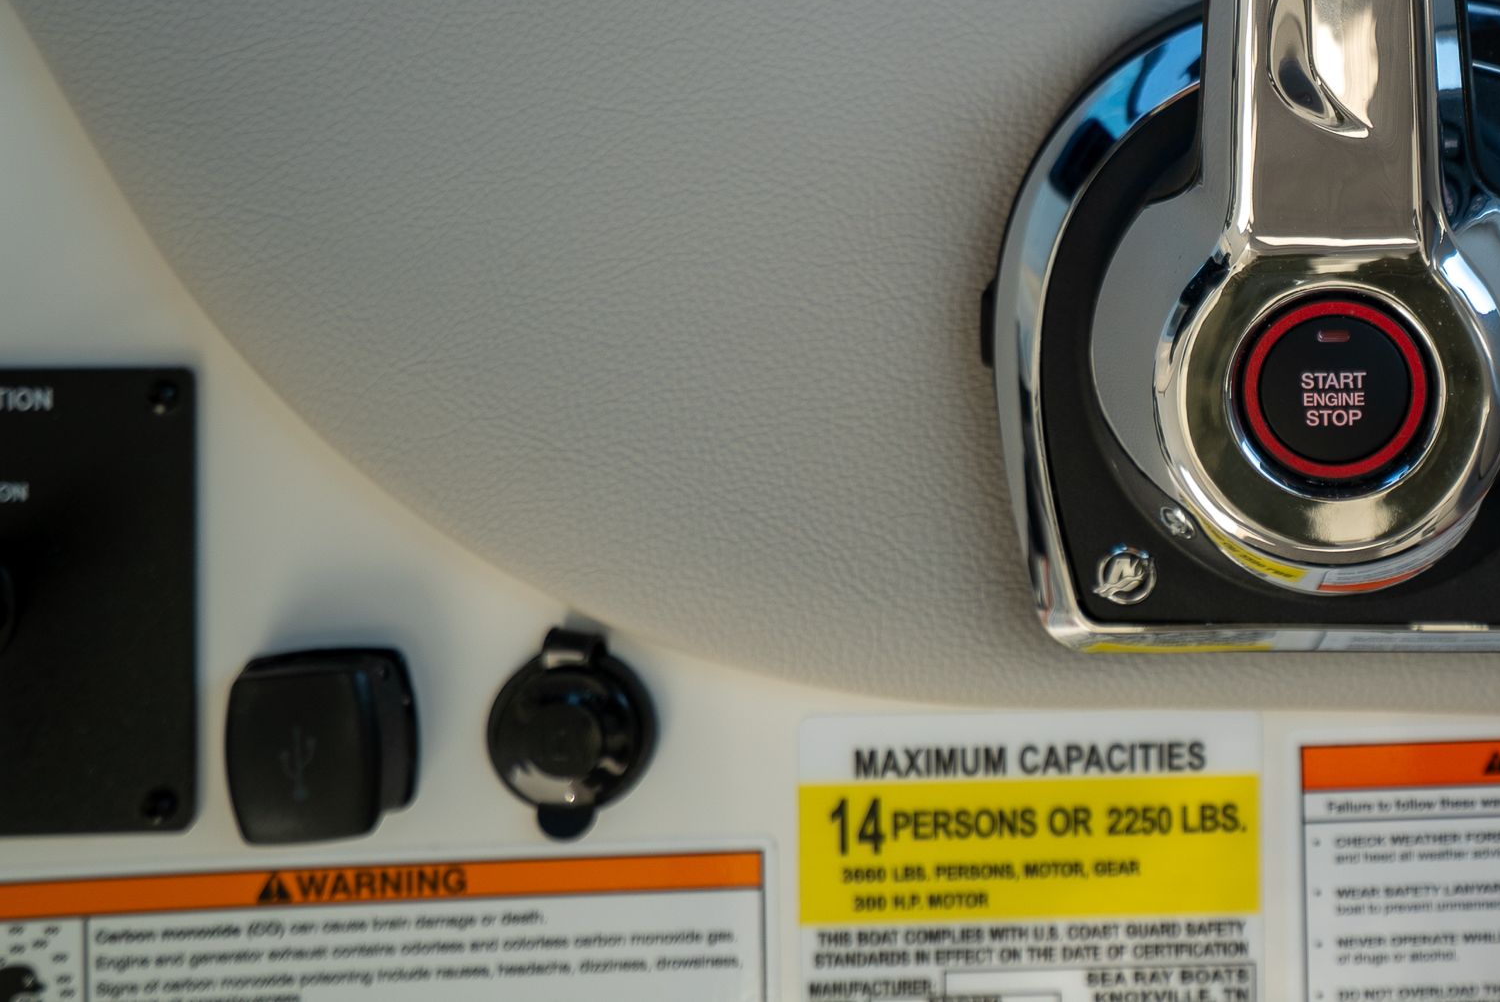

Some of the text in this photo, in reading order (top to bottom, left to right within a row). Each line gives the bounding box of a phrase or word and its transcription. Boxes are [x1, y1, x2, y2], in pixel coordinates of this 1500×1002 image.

[1301, 372, 1367, 389] START
[1303, 392, 1365, 407] ENGINE
[1306, 409, 1362, 426] STOP
[854, 741, 1206, 778] MAXIMUM CAPACITIES
[829, 797, 1247, 855] 14 PERSONS OR 2250 LBS.
[1094, 859, 1141, 876] GEAR
[297, 867, 467, 898] WARNING
[928, 892, 989, 909] MOTOR
[818, 931, 851, 947] THIS
[857, 930, 897, 946] BOAT
[905, 927, 983, 945] COMPLIES
[990, 926, 1028, 943] WITH
[1068, 923, 1119, 940] COAST
[1126, 921, 1181, 939] GUARD
[1185, 920, 1246, 937] SAFETY
[814, 941, 1249, 969] STANDARDS IN EFFECT ON THE DATE OF CERTIFICATION
[1086, 968, 1250, 986] SEA RAY BOATS
